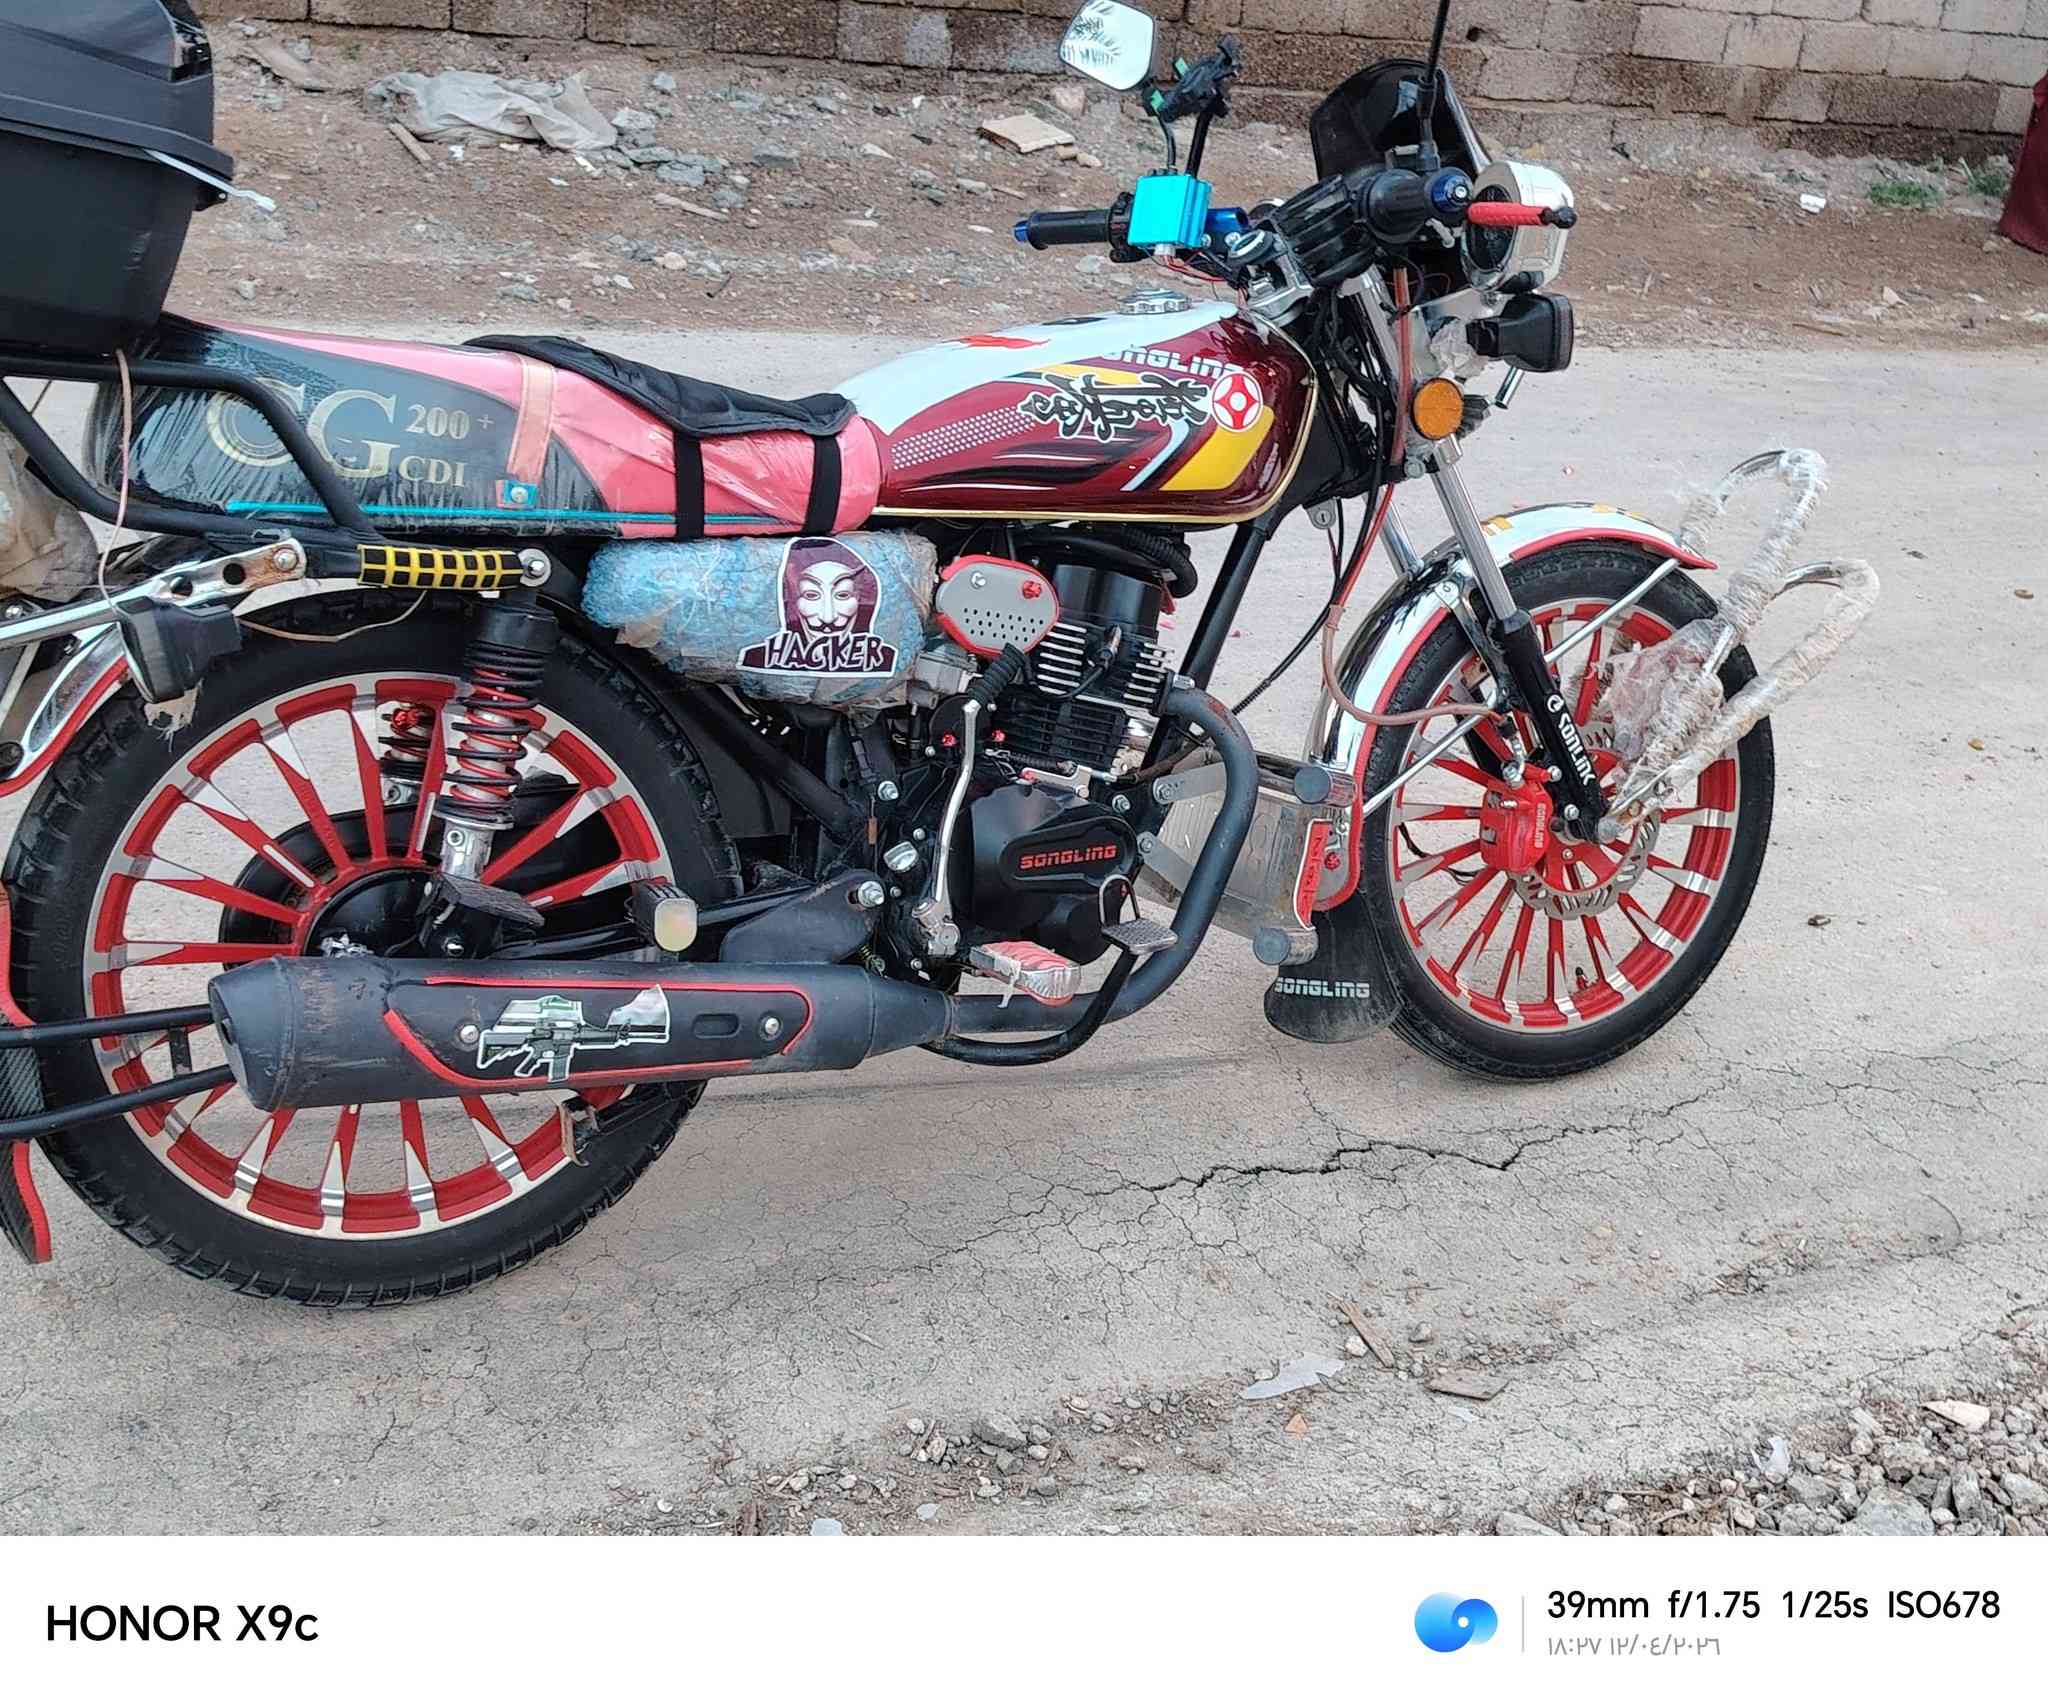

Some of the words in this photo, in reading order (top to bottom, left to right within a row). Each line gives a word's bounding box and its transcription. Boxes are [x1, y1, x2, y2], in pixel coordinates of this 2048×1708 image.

[206, 377, 400, 478] CG
[405, 404, 470, 440] 200
[399, 455, 468, 488] CDI
[765, 631, 884, 672] HACKER
[1019, 844, 1118, 870] SONGLING
